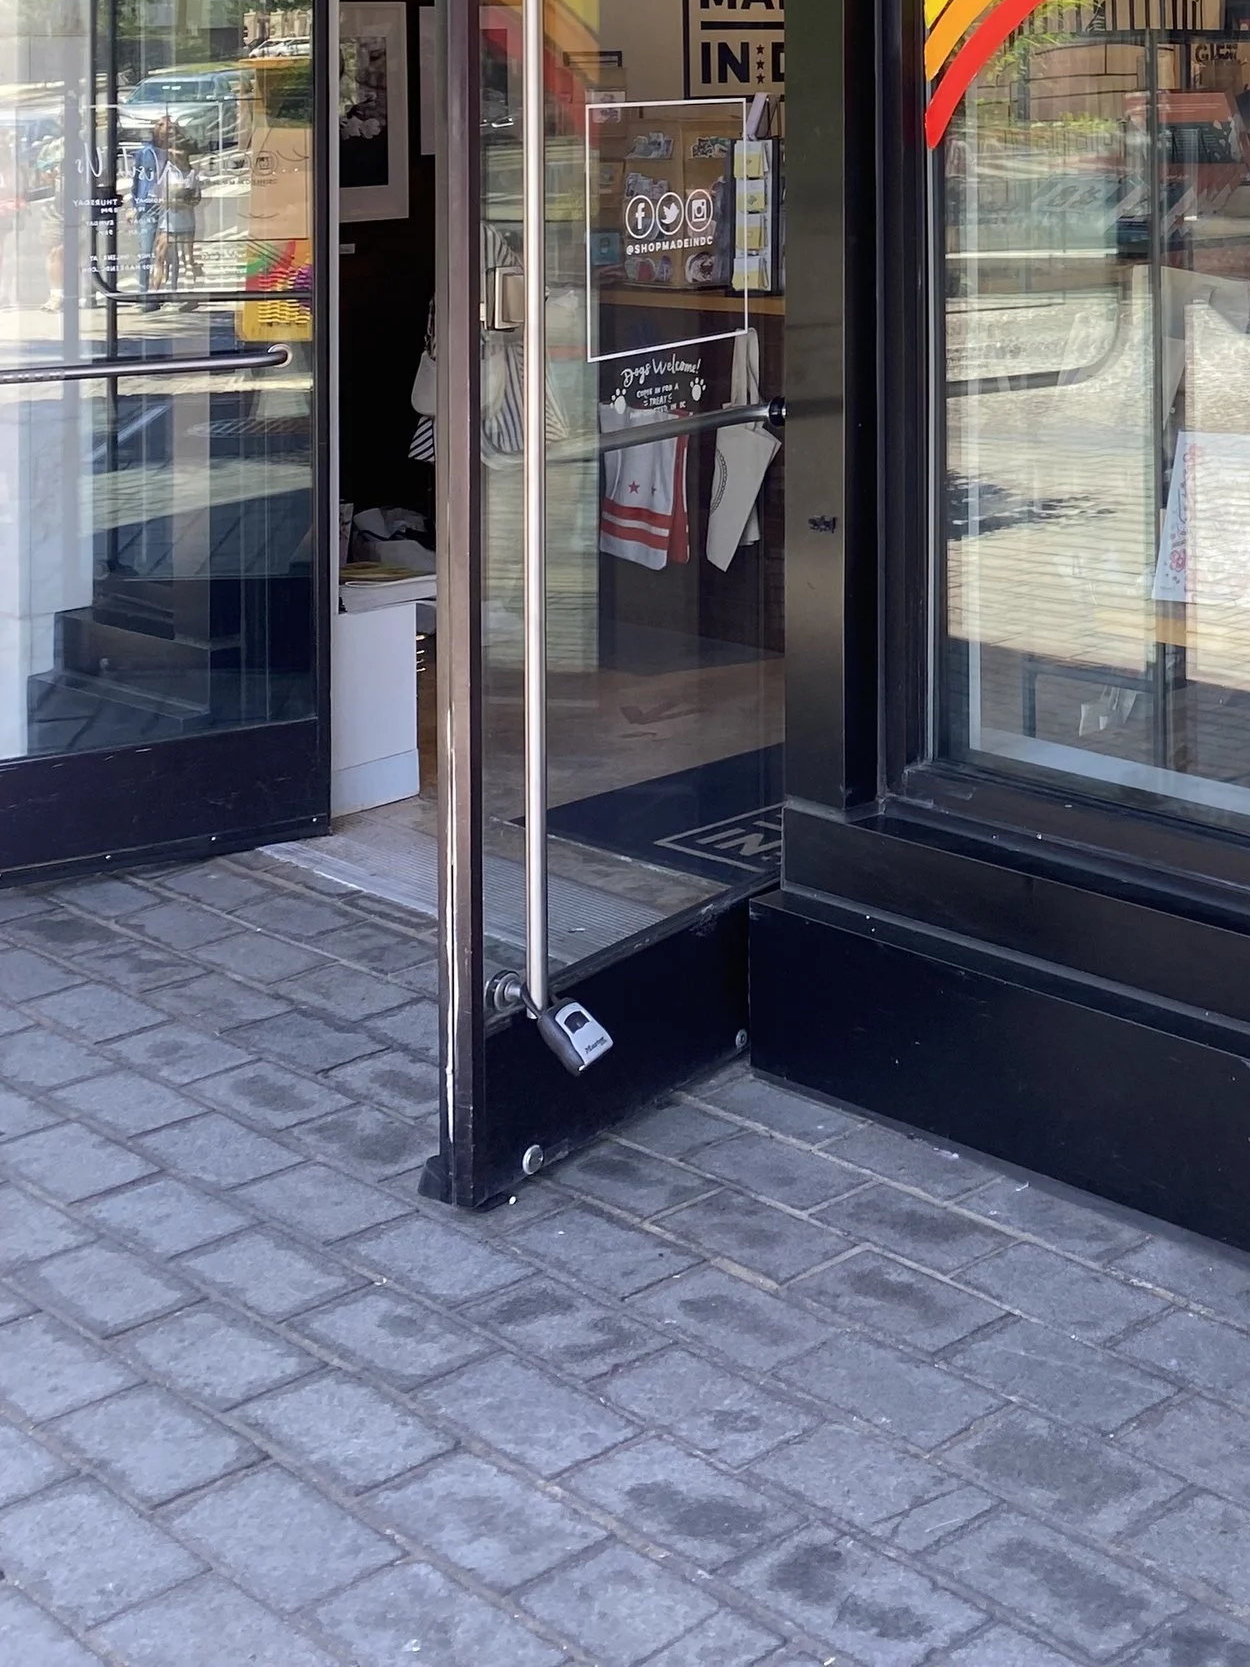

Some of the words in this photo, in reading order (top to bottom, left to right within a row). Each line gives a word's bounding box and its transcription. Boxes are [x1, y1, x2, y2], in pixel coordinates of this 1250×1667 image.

[625, 235, 714, 256] @SHOPMADEINDC
[620, 363, 652, 388] Dogs
[652, 353, 702, 375] Welcome!
